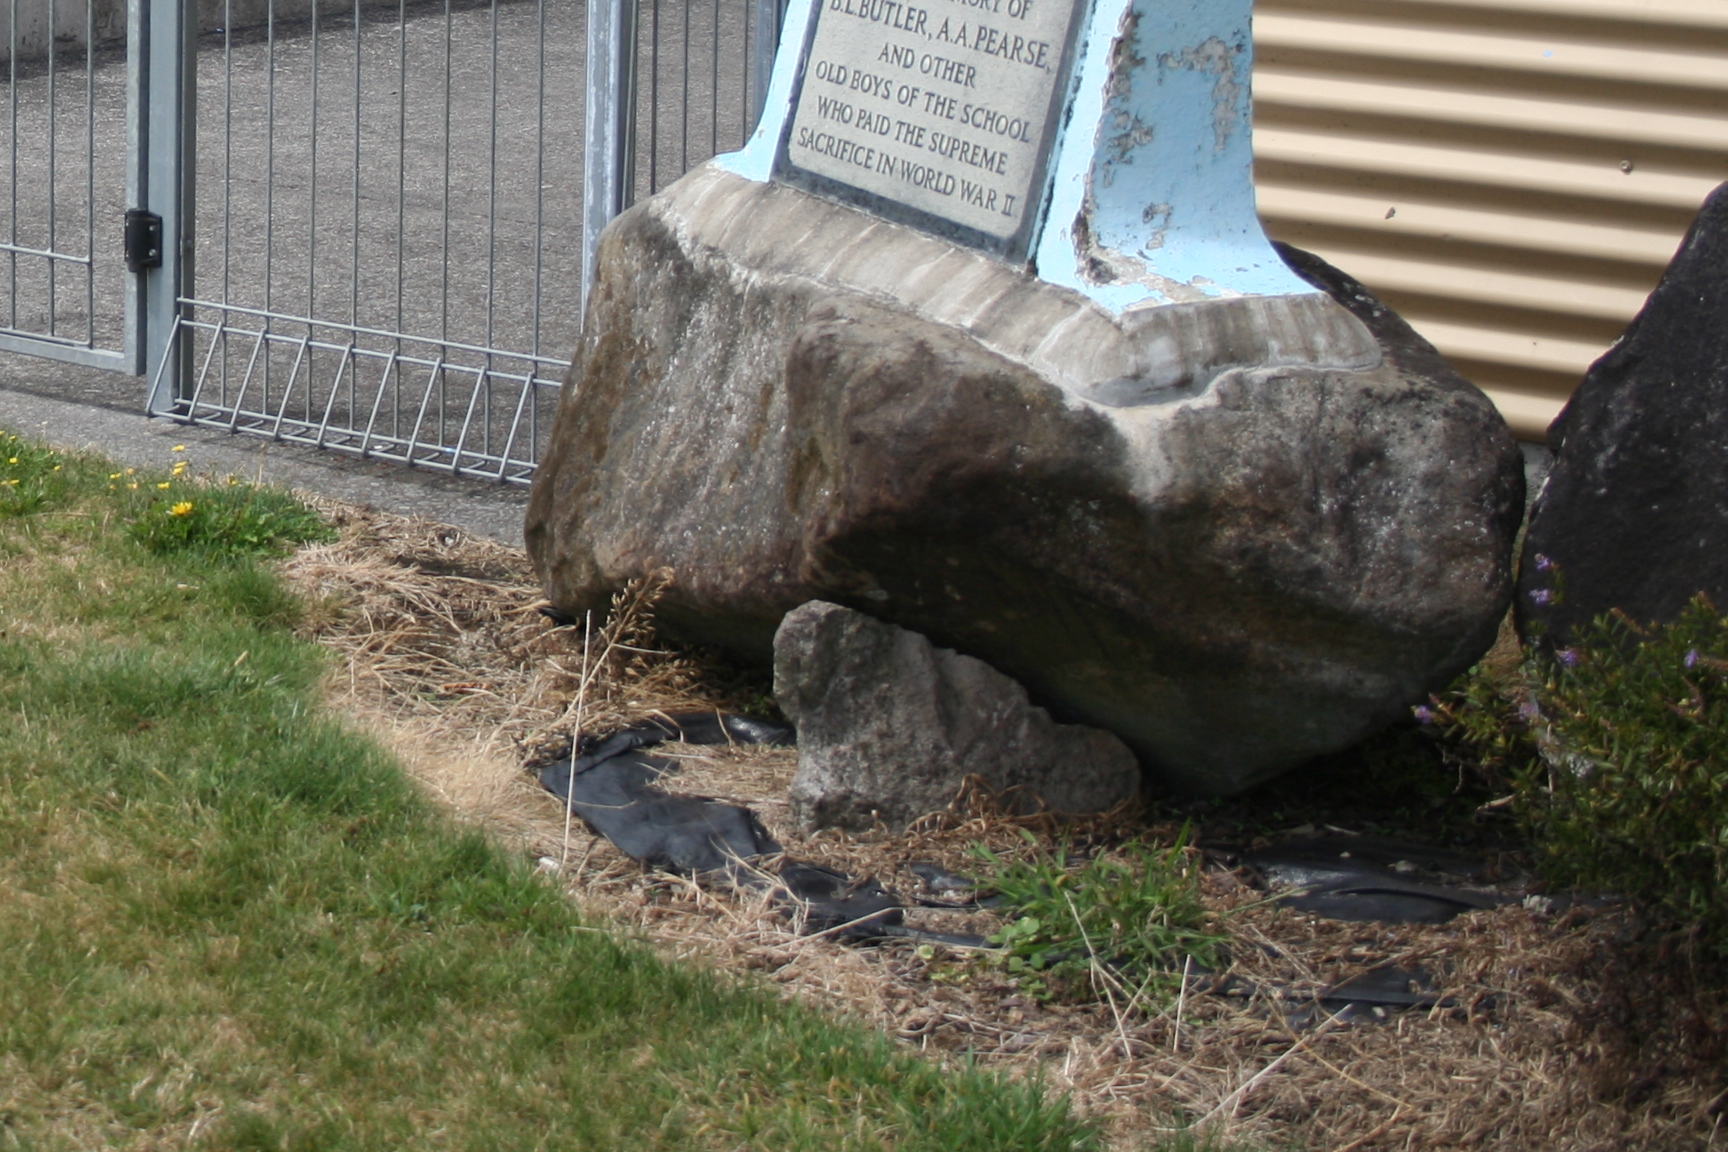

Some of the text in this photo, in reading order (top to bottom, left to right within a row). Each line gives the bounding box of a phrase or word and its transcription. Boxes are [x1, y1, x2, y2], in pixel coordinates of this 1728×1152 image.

[815, 60, 1031, 143] OLD BOYS OF THE SCHOOL
[877, 42, 976, 89] AND OTHER
[797, 127, 1016, 217] SACRIFICE IN WORLD WAR II
[817, 95, 1008, 176] WHO PAID THE SUPREME
